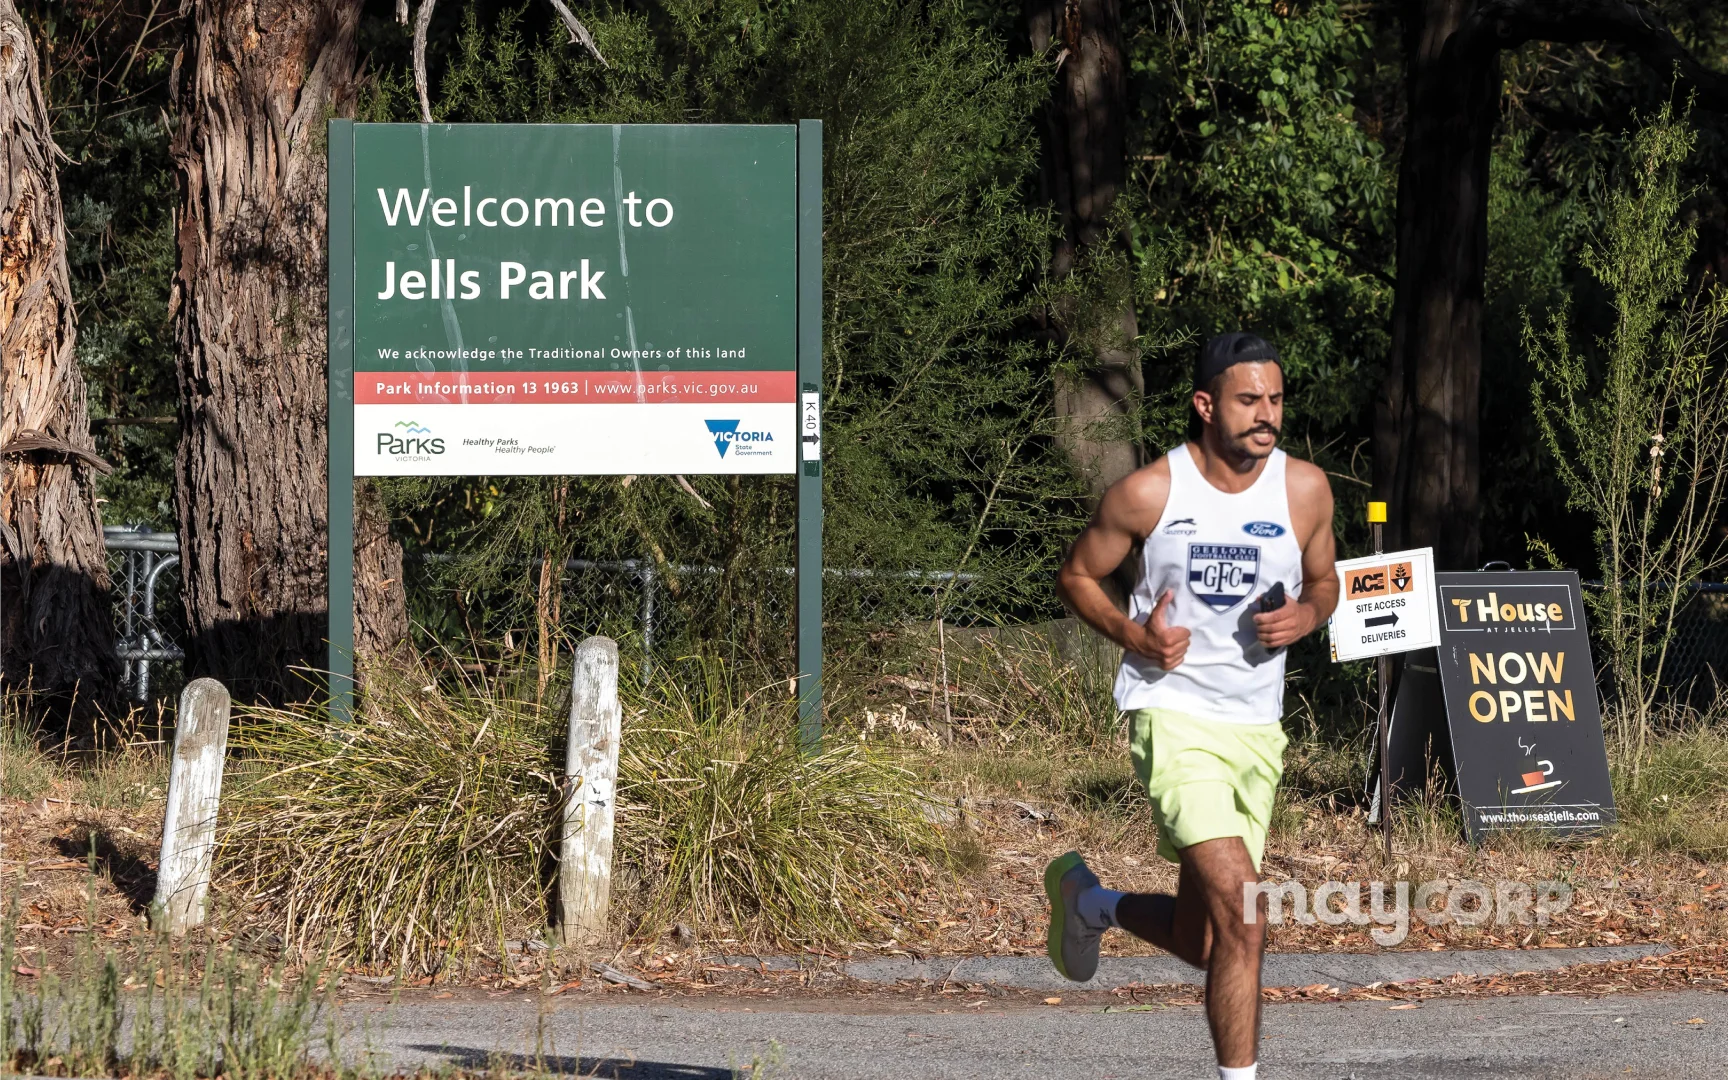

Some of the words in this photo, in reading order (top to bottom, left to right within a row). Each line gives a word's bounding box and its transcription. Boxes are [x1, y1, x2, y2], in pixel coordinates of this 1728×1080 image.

[378, 186, 605, 227] Welcome
[623, 191, 674, 227] to
[378, 259, 481, 300] Jells
[500, 259, 606, 299] Park
[378, 348, 399, 359] We
[405, 348, 496, 361] acknowledge
[501, 348, 523, 359] the
[529, 348, 605, 359] Traditional
[610, 348, 661, 359] Owners
[666, 348, 681, 359] of
[686, 348, 711, 359] this
[716, 348, 746, 359] land
[376, 382, 412, 394] Park
[418, 382, 516, 394] Information
[522, 382, 538, 394] 13
[543, 382, 579, 394] 1963
[594, 382, 758, 397] www.parks.vic.gov.au
[806, 402, 816, 411] K
[806, 414, 817, 430] 40
[377, 433, 446, 455] Parks
[462, 438, 495, 447] Healthy
[496, 438, 519, 446] Parks
[710, 431, 774, 442] VICTORIA
[495, 446, 526, 455] Healthy
[1250, 524, 1278, 537] Ford
[1192, 546, 1256, 556] GEELONG
[1203, 562, 1243, 593] GFC
[1351, 573, 1385, 594] ACE
[1356, 602, 1373, 614] SITE
[1374, 598, 1406, 611] ACCESS
[1476, 592, 1564, 623] House
[1361, 629, 1406, 644] DELIVERIES
[1468, 651, 1565, 685] NOW
[1468, 689, 1576, 723] OPEN
